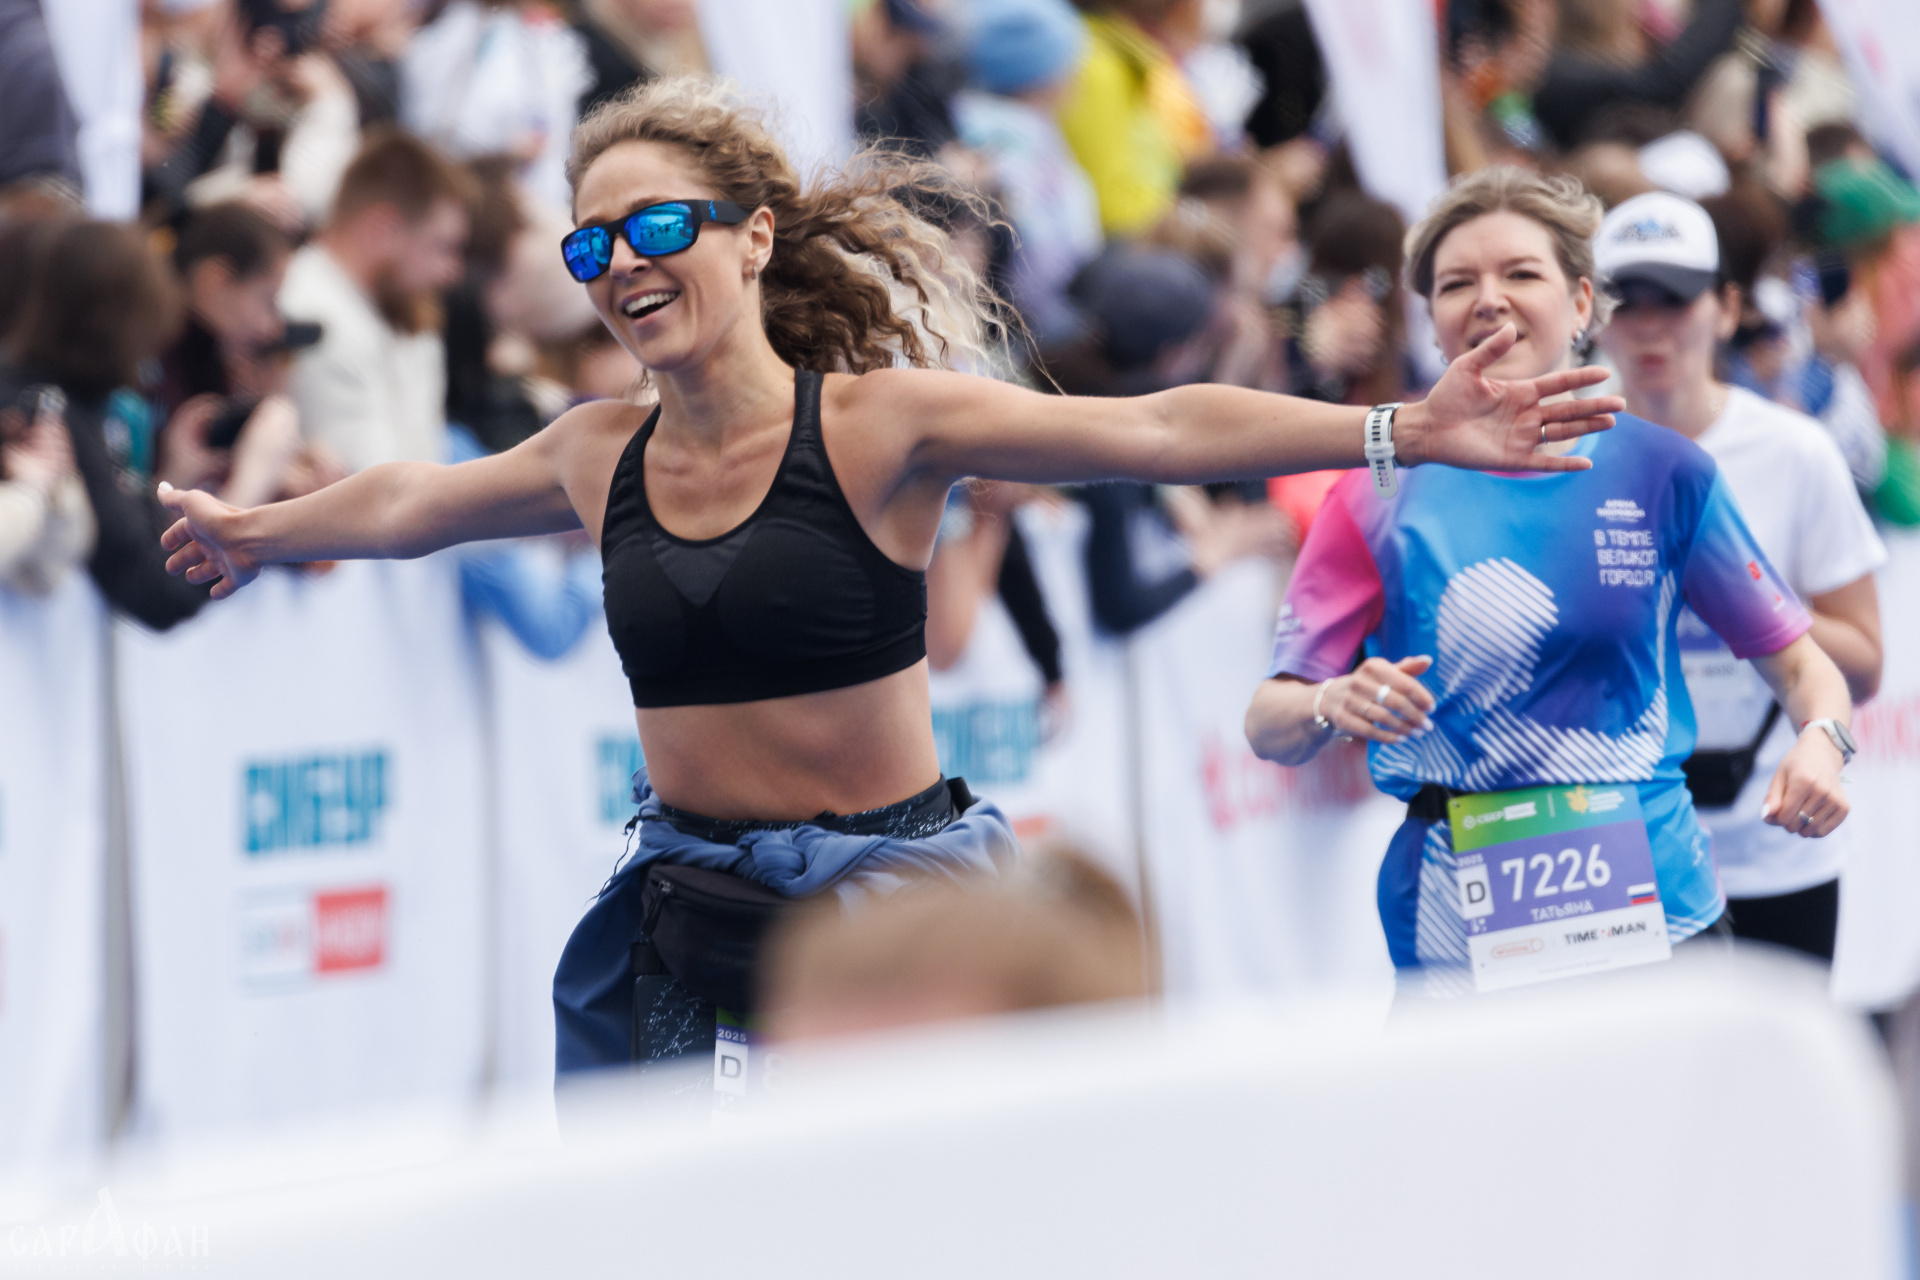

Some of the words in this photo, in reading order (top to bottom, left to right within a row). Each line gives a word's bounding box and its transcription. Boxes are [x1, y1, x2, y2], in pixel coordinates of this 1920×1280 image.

[1594, 529, 1606, 546] В
[1501, 843, 1611, 902] 7226
[1466, 881, 1486, 904] D
[1530, 899, 1594, 922] ТАТЬЯНА
[717, 1027, 747, 1043] 2025
[720, 1054, 742, 1079] D
